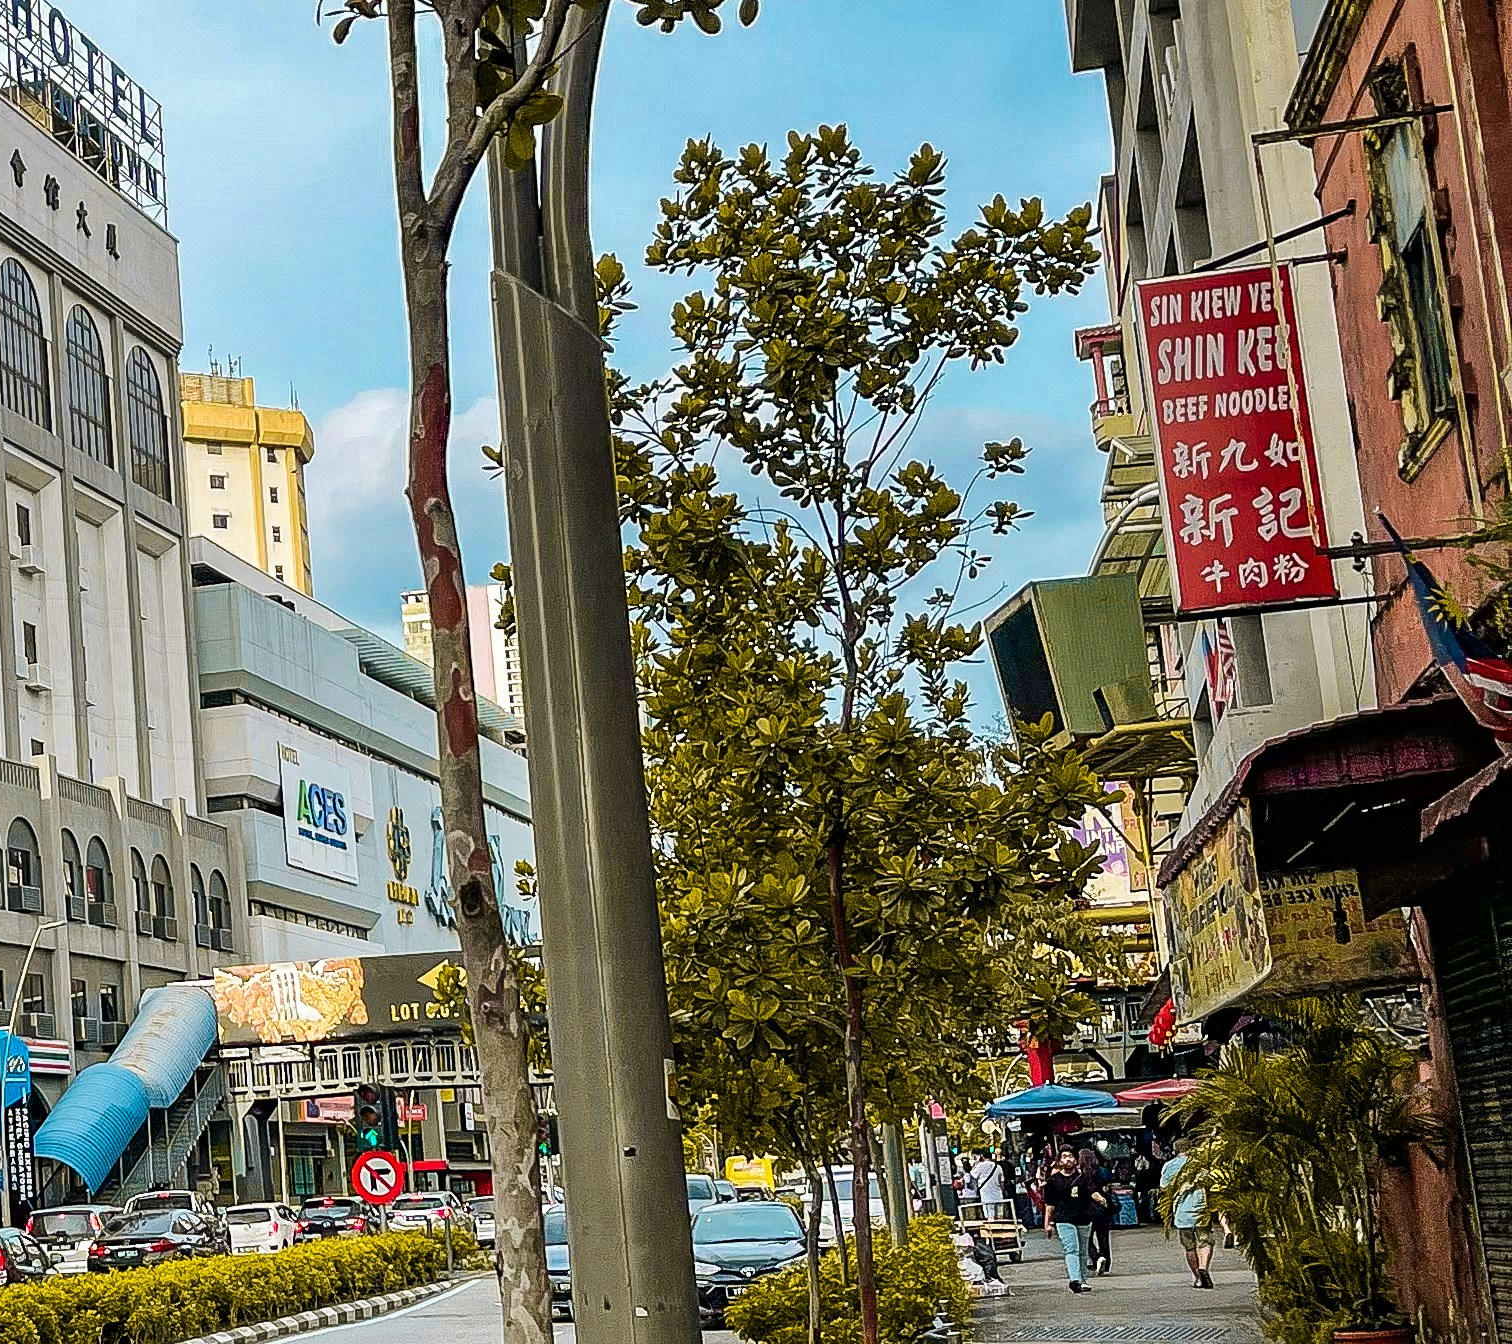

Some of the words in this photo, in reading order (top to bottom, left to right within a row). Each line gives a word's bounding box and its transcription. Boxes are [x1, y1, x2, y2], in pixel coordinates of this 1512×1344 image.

[1150, 293, 1182, 327] SIN
[1190, 285, 1242, 324] KIEW
[1157, 333, 1225, 385] SHIN
[1237, 324, 1291, 378] KEE
[1162, 395, 1208, 425] BEEF
[1214, 383, 1299, 420] NOODLE
[1172, 432, 1304, 480] 新九如
[1179, 486, 1317, 548] 新記
[1200, 552, 1310, 594] 牛肉粉
[296, 778, 348, 836] ACES
[390, 1002, 420, 1022] LOT
